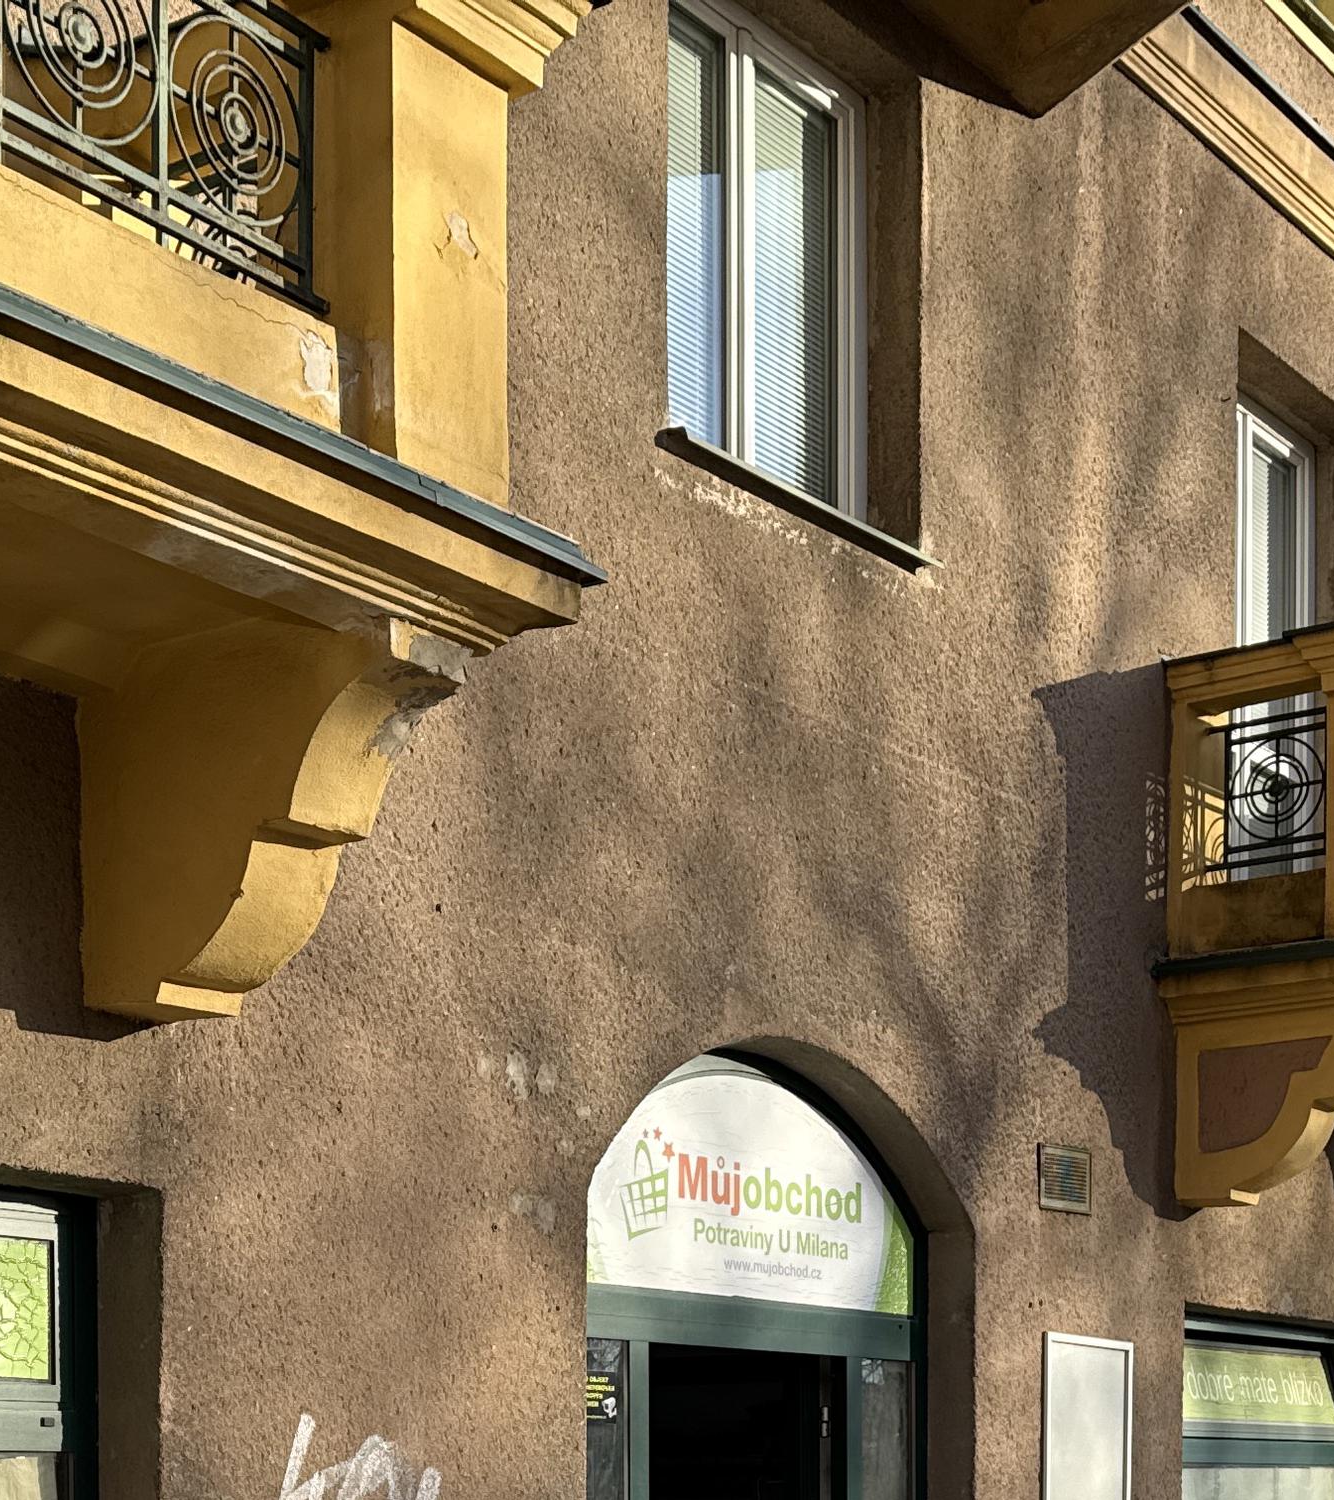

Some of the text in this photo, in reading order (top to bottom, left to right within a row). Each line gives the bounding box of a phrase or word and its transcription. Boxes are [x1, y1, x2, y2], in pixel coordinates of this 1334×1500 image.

[677, 1152, 863, 1224] Můjobchod
[693, 1217, 849, 1261] Potraviny U Milana
[723, 1256, 823, 1281] www.mujobchod.cz
[1186, 1364, 1234, 1402] dobré
[1239, 1368, 1279, 1404] máte
